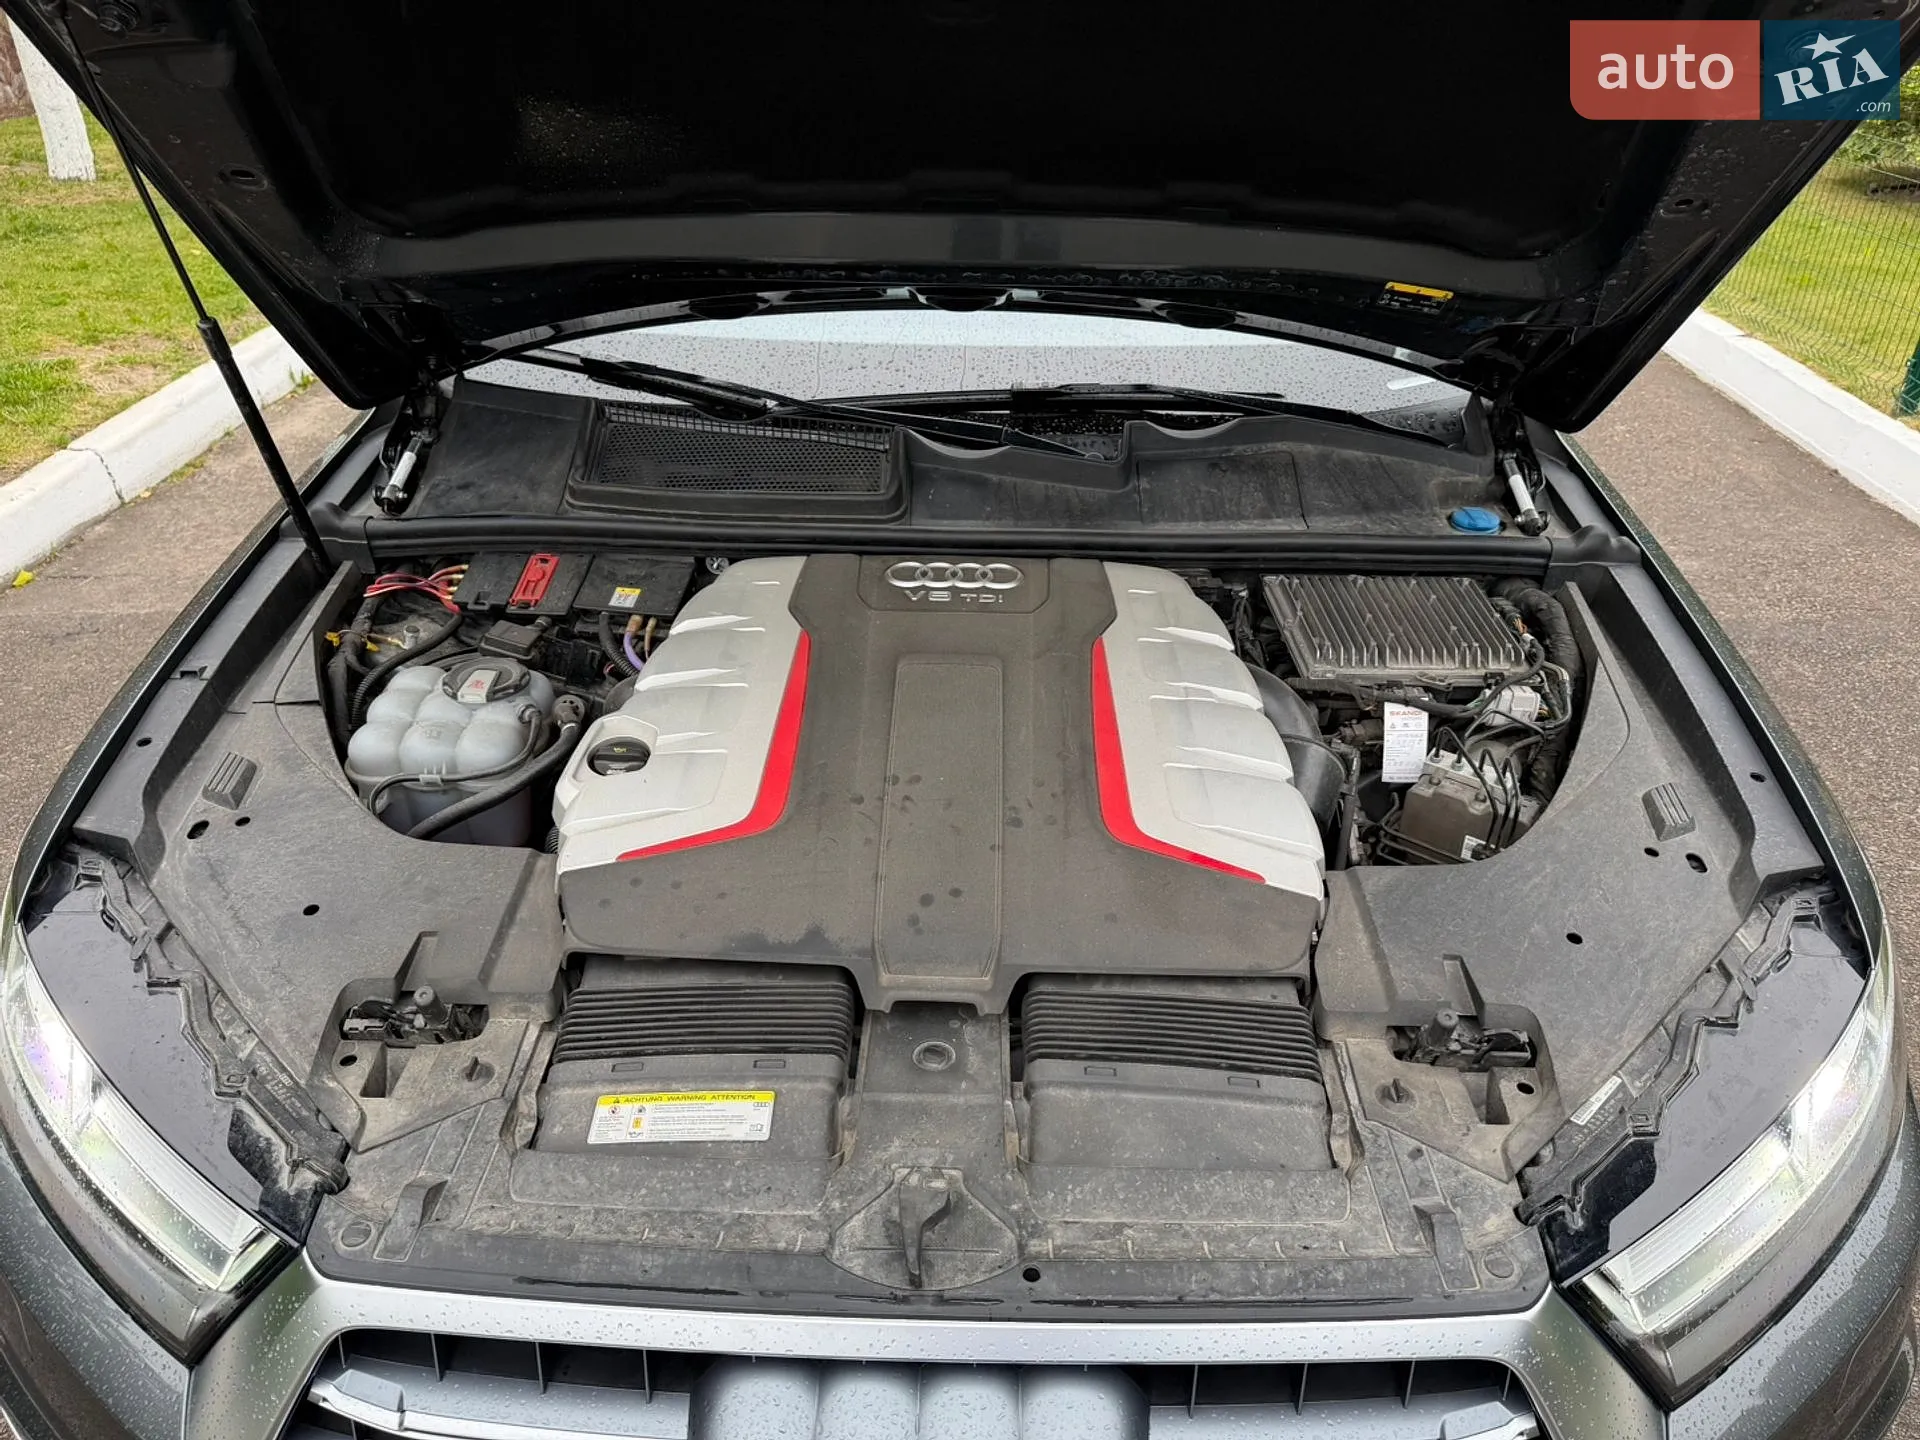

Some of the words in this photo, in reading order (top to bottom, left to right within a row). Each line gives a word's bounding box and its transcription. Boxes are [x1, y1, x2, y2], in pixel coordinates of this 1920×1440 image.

[904, 590, 952, 602] V8
[624, 1095, 663, 1103] ACHTUNG
[667, 1094, 707, 1102] WARNING
[711, 1093, 756, 1101] ATTENTION
